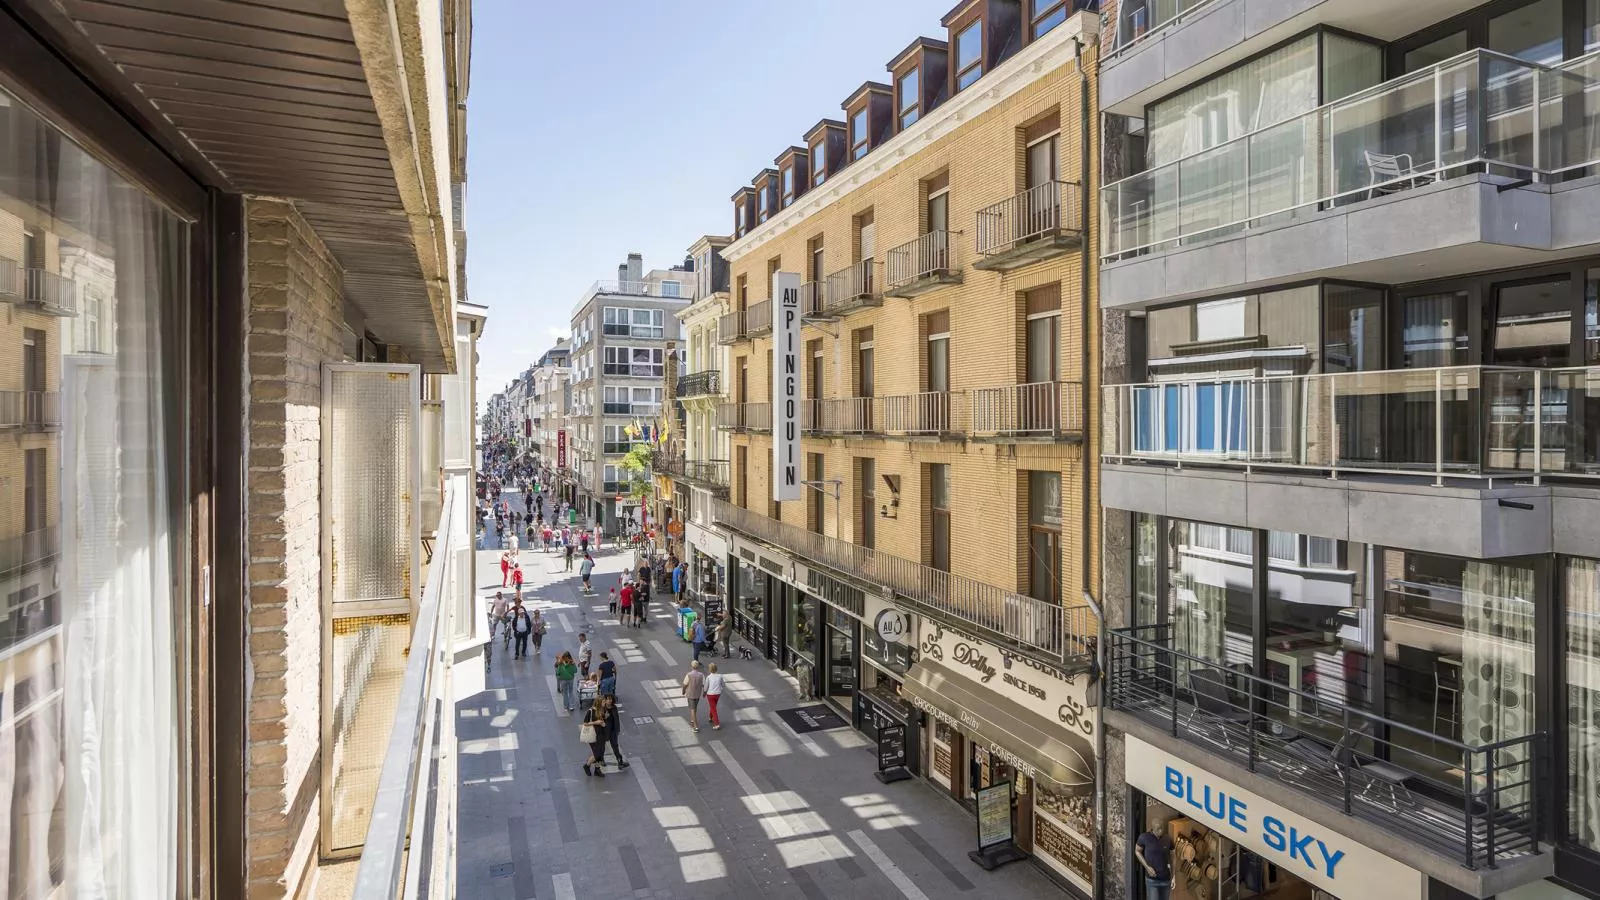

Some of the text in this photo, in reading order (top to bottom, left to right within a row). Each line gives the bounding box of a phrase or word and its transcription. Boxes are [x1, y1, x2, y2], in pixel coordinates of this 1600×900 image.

[783, 288, 797, 304] AU
[785, 310, 796, 486] PINGOUIN
[883, 621, 893, 632] AU
[1003, 672, 1047, 701] SINCE 1958
[914, 696, 960, 730] CHOCOLATERIE
[990, 742, 1036, 779] CONFISERIE
[1165, 766, 1346, 880] BLUE SKY
